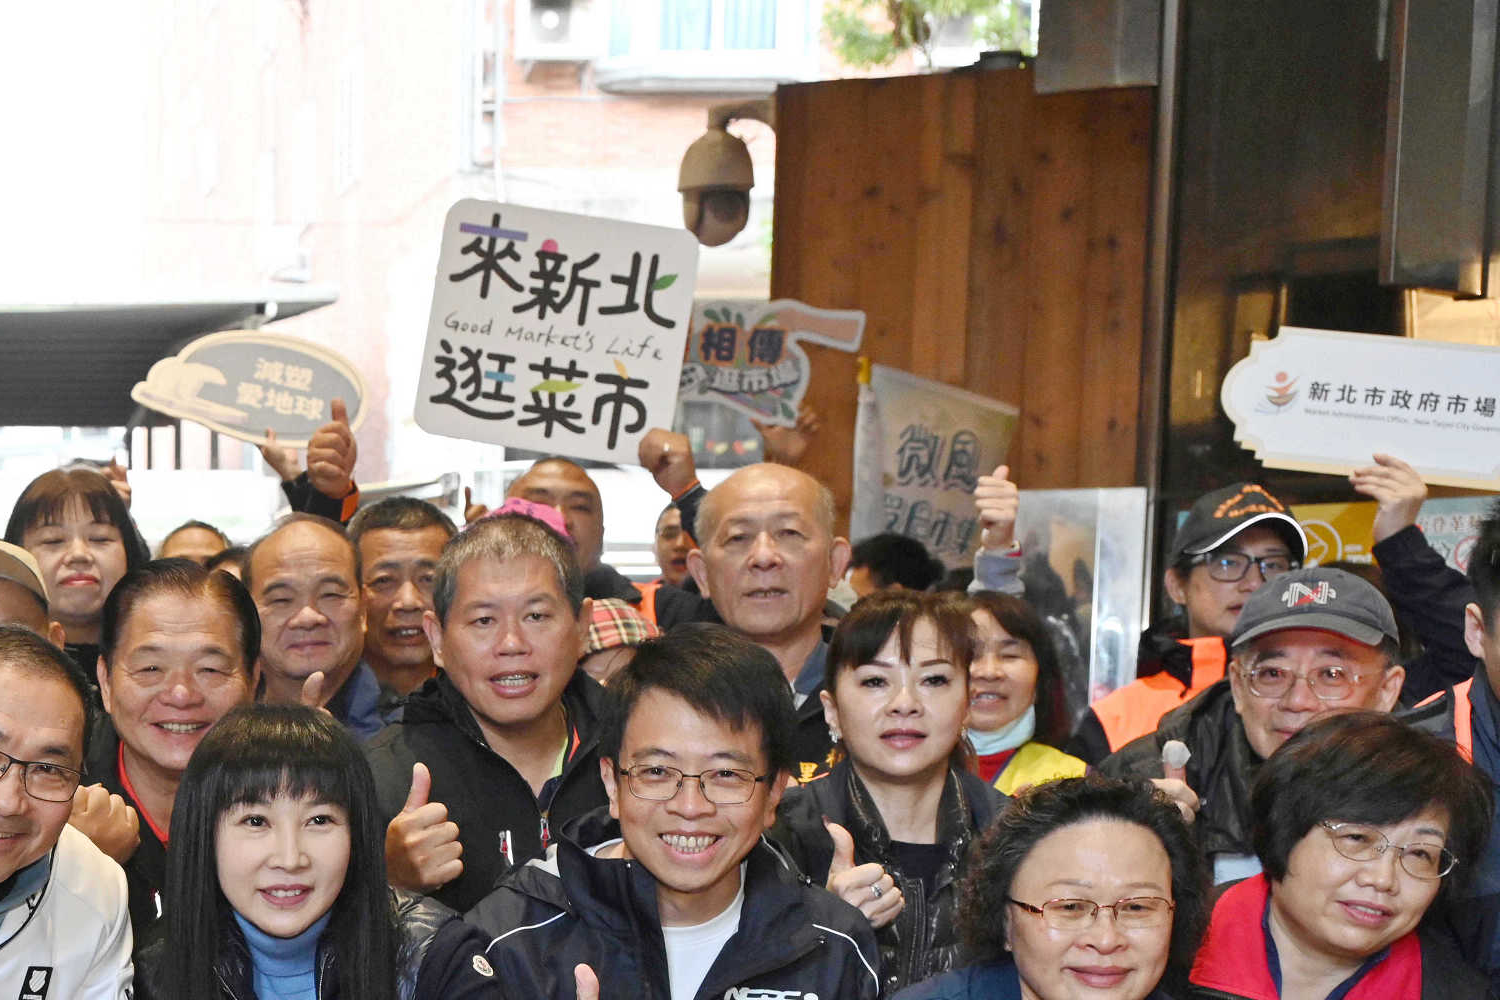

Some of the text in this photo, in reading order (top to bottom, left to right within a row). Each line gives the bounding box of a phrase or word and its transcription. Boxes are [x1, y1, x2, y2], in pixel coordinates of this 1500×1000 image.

[449, 212, 678, 329] 來新北
[444, 311, 664, 360] Good Market's Life
[253, 357, 314, 392] 減塑
[429, 338, 650, 450] 逛菜市
[236, 381, 325, 421] 愛地球
[1307, 381, 1497, 418] 新北市政府市場
